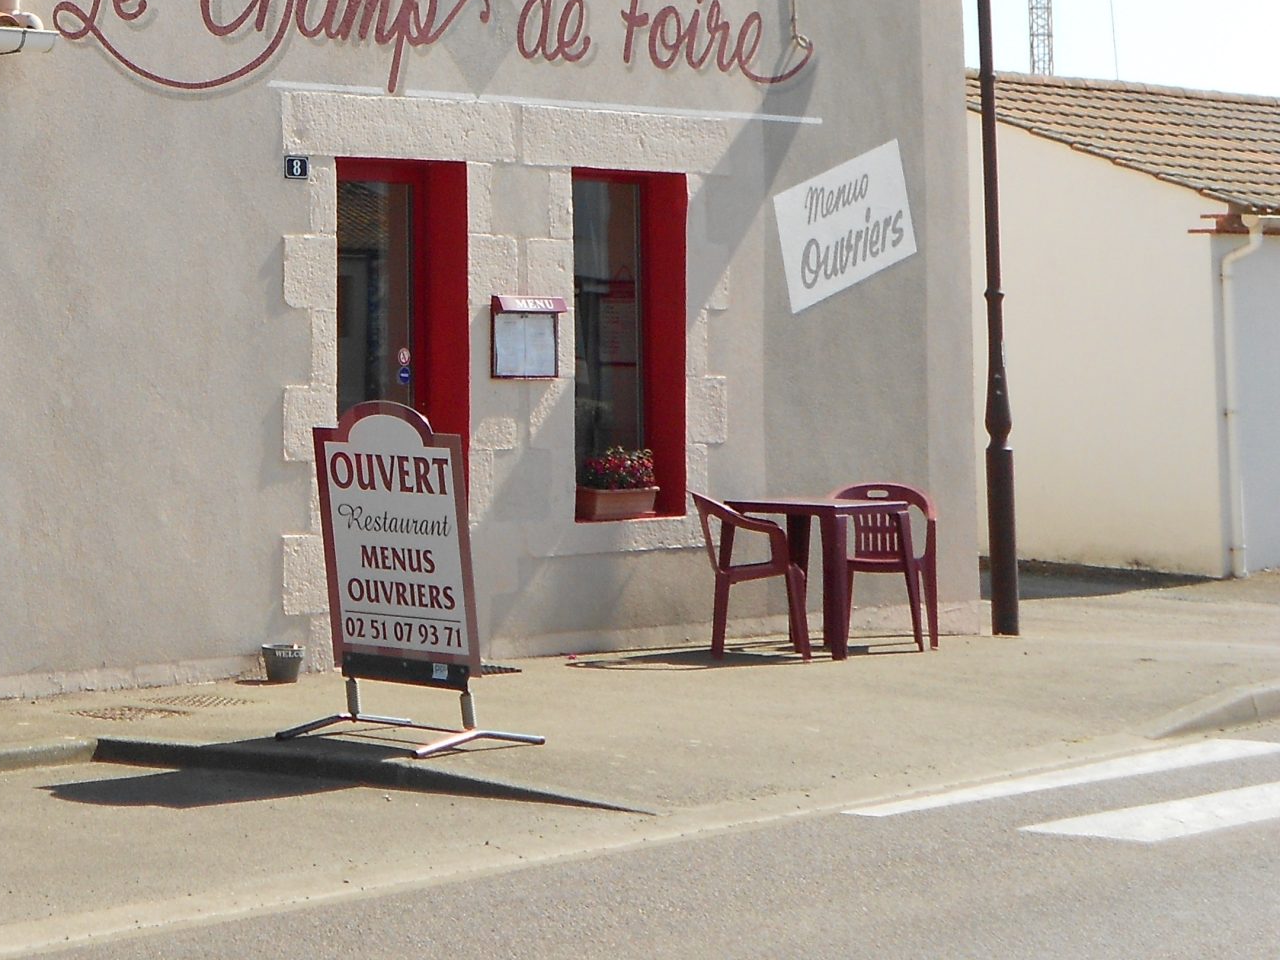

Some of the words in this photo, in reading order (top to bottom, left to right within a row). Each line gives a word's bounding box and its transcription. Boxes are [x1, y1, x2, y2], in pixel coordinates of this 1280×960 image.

[293, 160, 302, 176] 8
[801, 207, 904, 289] Ouvriers
[516, 299, 554, 309] MENU
[329, 451, 449, 495] OUVERT
[337, 503, 451, 538] Restaurant
[360, 544, 436, 574] MENUS
[347, 577, 456, 611] OUVRIERS
[345, 617, 366, 637] 02
[371, 619, 388, 640] 51
[394, 621, 413, 642] 07
[418, 623, 439, 645] 93
[444, 626, 462, 648] 71
